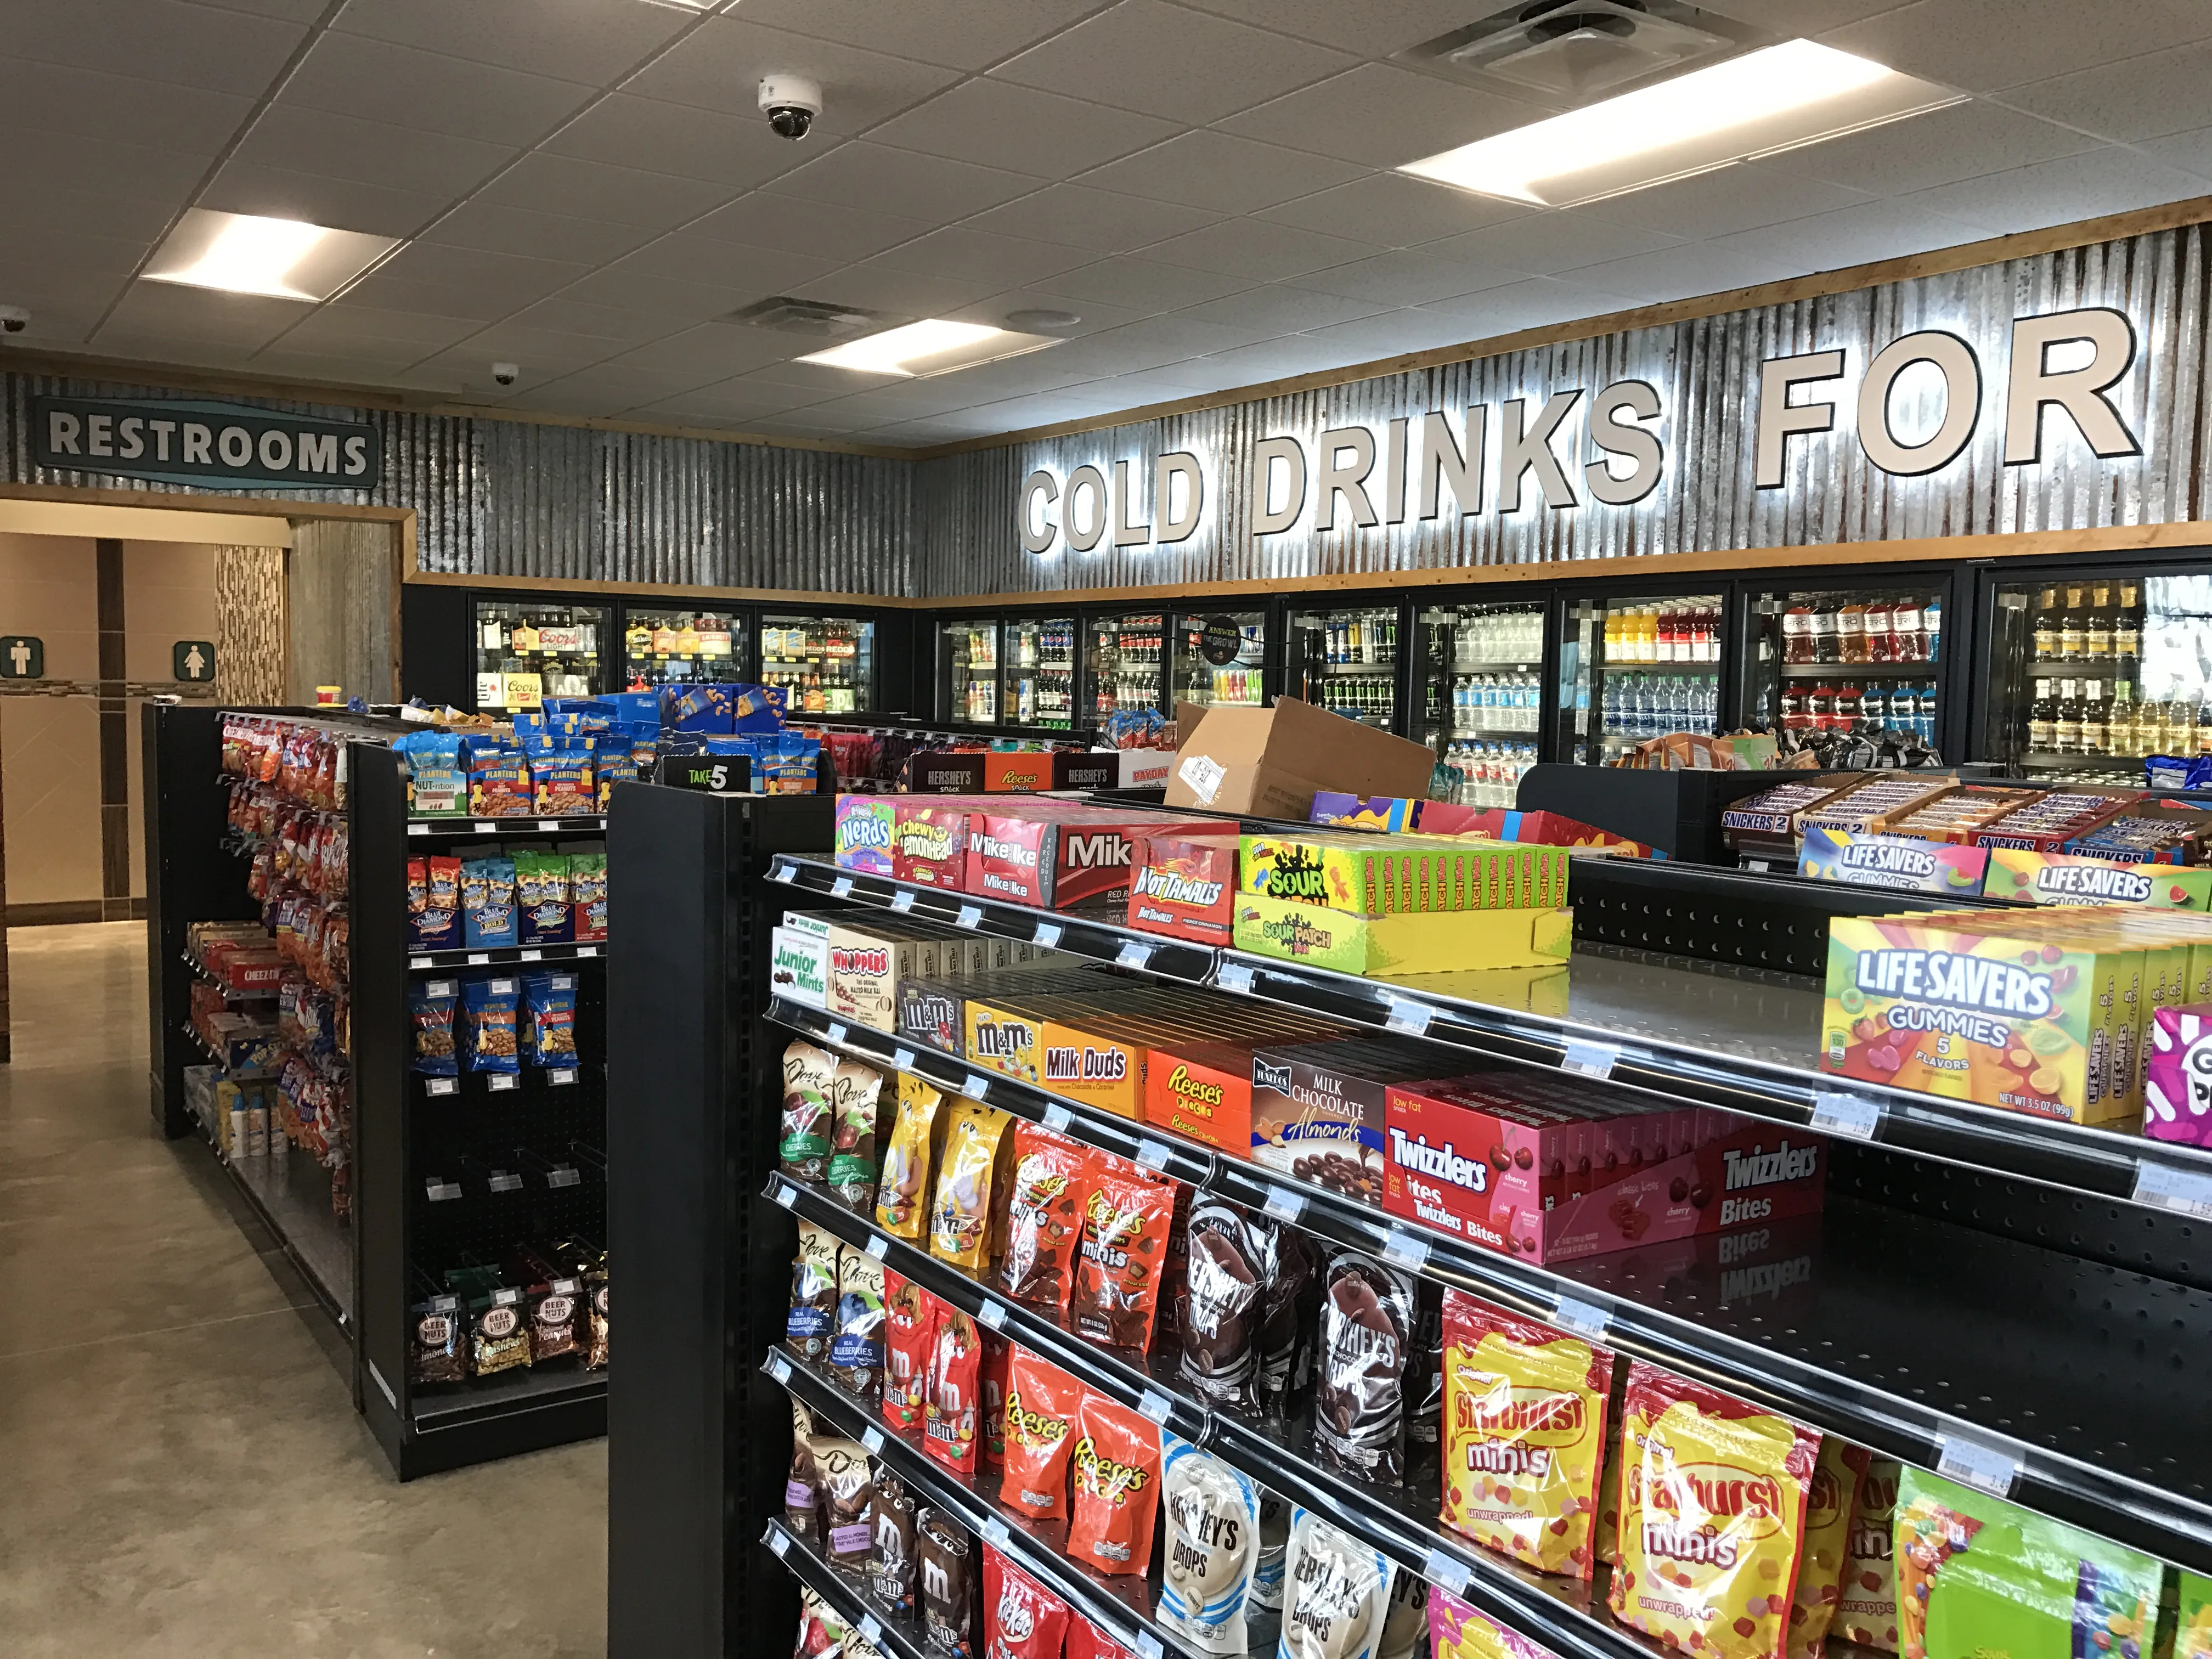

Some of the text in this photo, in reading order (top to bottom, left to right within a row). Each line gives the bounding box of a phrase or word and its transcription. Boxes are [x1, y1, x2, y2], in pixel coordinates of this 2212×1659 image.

[1019, 308, 2143, 554] COLD DRINKS FOR
[49, 410, 366, 476] RESTROOMS
[1209, 627, 1236, 636] ANSWER
[1212, 636, 1238, 648] GROWL
[507, 680, 539, 692] Coors
[419, 770, 451, 778] PLANTERS
[486, 770, 517, 778] PLANTERS
[550, 771, 580, 779] PLANTERS
[689, 765, 729, 789] TAKE 5
[928, 770, 971, 785] HERSHEY'S
[1002, 770, 1039, 783] Reese's
[1068, 769, 1108, 783] HERSHEY'S
[1132, 766, 1169, 782] PAYDAY
[415, 781, 454, 790] NUT-rition
[902, 821, 934, 836] chewy
[1723, 812, 1787, 830] SNICKERS 2
[971, 833, 1036, 866] Mike Ike
[1068, 836, 1132, 867] Mik
[1252, 842, 1265, 855] SOUR
[984, 874, 1028, 896] Mike Ike
[1133, 866, 1223, 906] HOT TAMALES
[1271, 870, 1323, 896] SOUR
[1107, 890, 1122, 899] RED
[1365, 882, 1375, 913] ATCH
[1420, 881, 1429, 912] ATCH
[1472, 881, 1481, 910] ATCH
[1523, 877, 1531, 908] ATCH
[477, 909, 509, 921] DIAMOND
[534, 907, 565, 919] DIAMOND
[541, 905, 556, 913] BLUE
[1137, 907, 1173, 923] HOT TAMALES
[1242, 907, 1252, 917] SOUR
[417, 913, 451, 926] DIAMOND
[1198, 921, 1222, 929] CINNAMON
[1263, 921, 1295, 940] SOUR
[1295, 927, 1331, 949] PATCH
[1294, 942, 1309, 954] Kids
[775, 946, 817, 974] Junior
[832, 951, 887, 974] WHOPPERS
[797, 972, 823, 993] Mints
[2101, 995, 2108, 1007] 5
[2125, 990, 2132, 1003] 5
[2152, 988, 2159, 1001] 5
[1887, 1007, 2009, 1048] GUMMIES
[1937, 1038, 1951, 1054] 5
[1046, 1046, 1127, 1080] Milk Duds
[1916, 1051, 1970, 1070] FLAVORS
[1167, 1064, 1224, 1107] Reese's
[1257, 1069, 1288, 1087] TUXEDOS
[1313, 1073, 1343, 1096] MILK
[1293, 1085, 1364, 1120] CHOCOLATE
[1393, 1096, 1421, 1113] low fat
[1999, 1093, 2074, 1118] NET WT 3.5 OZ (99g)
[1171, 1114, 1199, 1136] Reese's
[1288, 1106, 1362, 1148] Almonds
[1389, 1127, 1486, 1192] Twizzlers
[1723, 1141, 1818, 1191] Twizzlers
[1389, 1172, 1401, 1183] low
[1504, 1173, 1528, 1187] cherry
[1389, 1183, 1400, 1193] fat
[1087, 1189, 1146, 1235] Reese's
[1520, 1210, 1539, 1221] cherry
[1667, 1206, 1690, 1218] cherry
[1720, 1197, 1771, 1226] Bites
[1413, 1199, 1503, 1245] Twizzlers Bites
[1082, 1240, 1127, 1268] minis
[489, 1312, 509, 1323] BEER
[545, 1308, 566, 1318] NUTS
[1189, 1302, 1220, 1339] DROPS
[425, 1321, 446, 1329] BEER
[490, 1321, 510, 1332] NUTS
[425, 1330, 447, 1339] NUTS
[486, 1339, 520, 1356] ashews
[834, 1346, 873, 1356] BLUEBERRIES
[893, 1349, 910, 1378] m
[940, 1382, 960, 1411] m
[1007, 1392, 1069, 1442] Reese's
[1075, 1438, 1150, 1491] Reese's
[1467, 1438, 1549, 1476] minis
[1170, 1492, 1239, 1550] HERHEY'S
[1173, 1538, 1207, 1577] DROPS
[924, 1558, 951, 1605] m
[1841, 1599, 1896, 1615] wrappe
